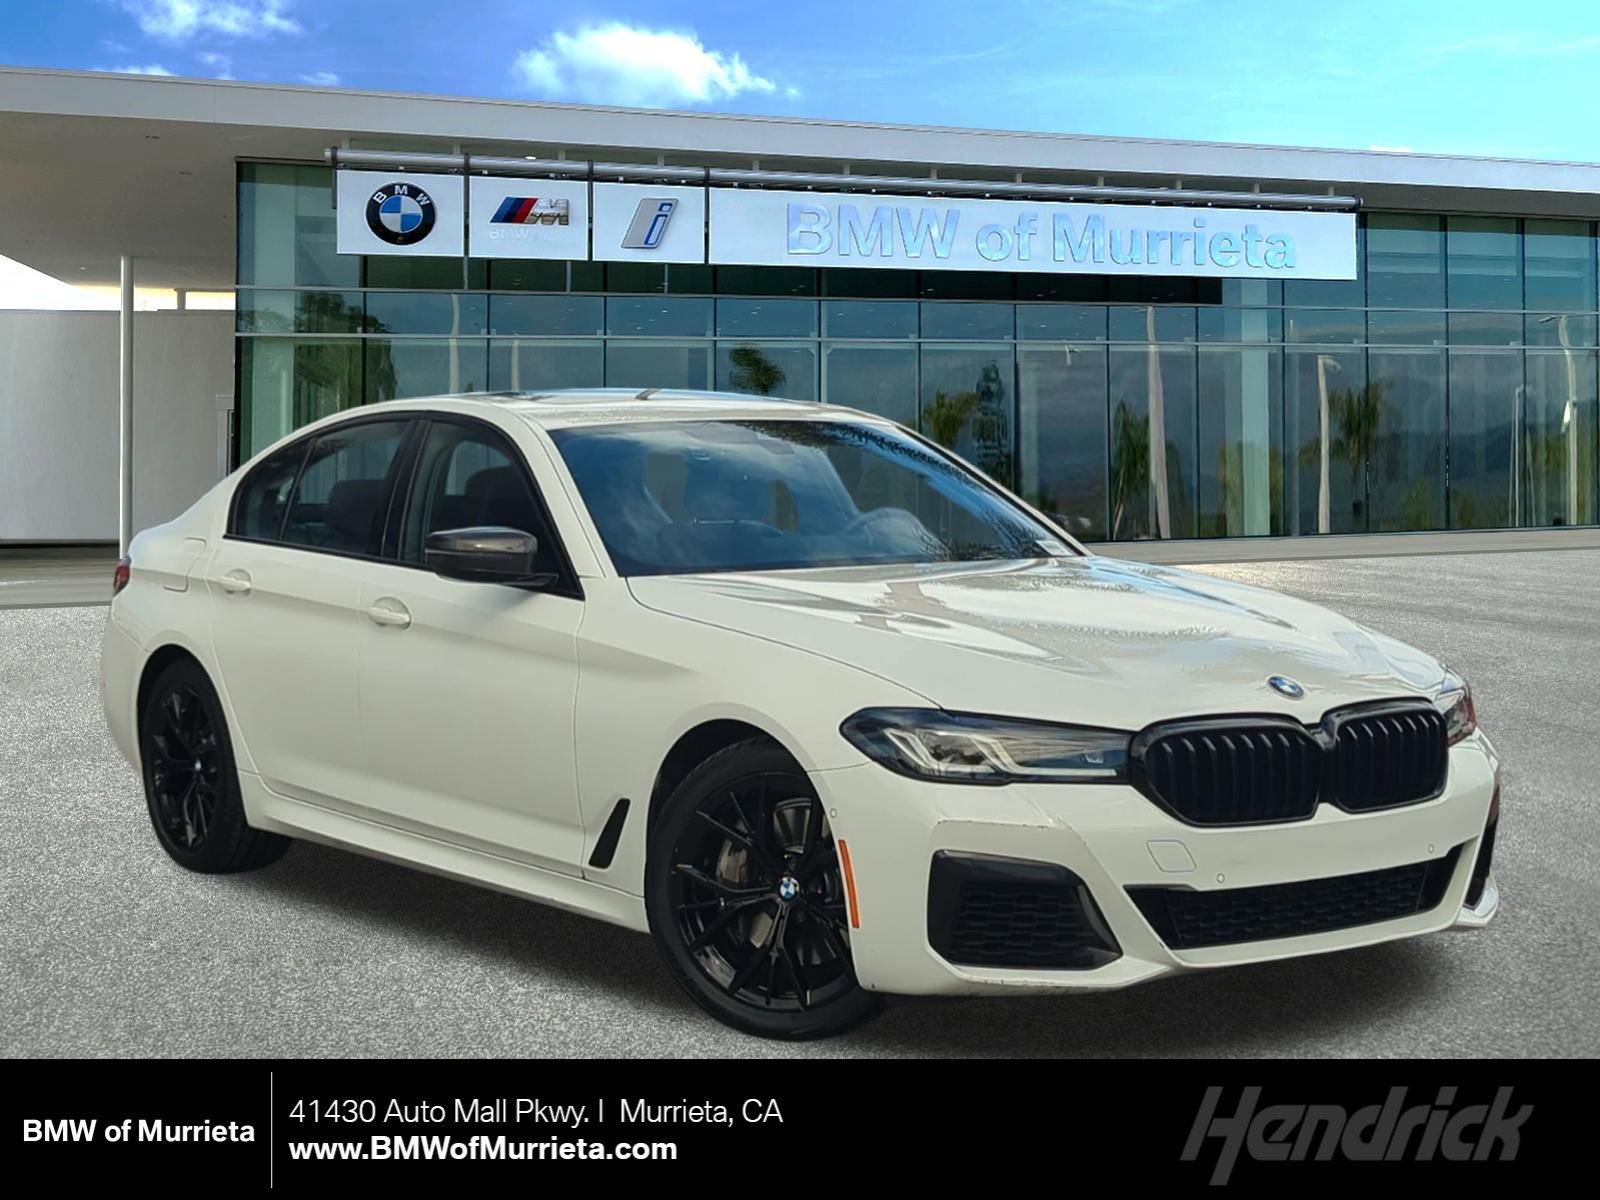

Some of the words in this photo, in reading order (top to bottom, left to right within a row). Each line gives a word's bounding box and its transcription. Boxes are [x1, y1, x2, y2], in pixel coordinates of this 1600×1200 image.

[372, 184, 431, 207] BMW
[785, 201, 961, 260] BMW
[975, 213, 1039, 262] of
[1051, 211, 1298, 269] Murrieta
